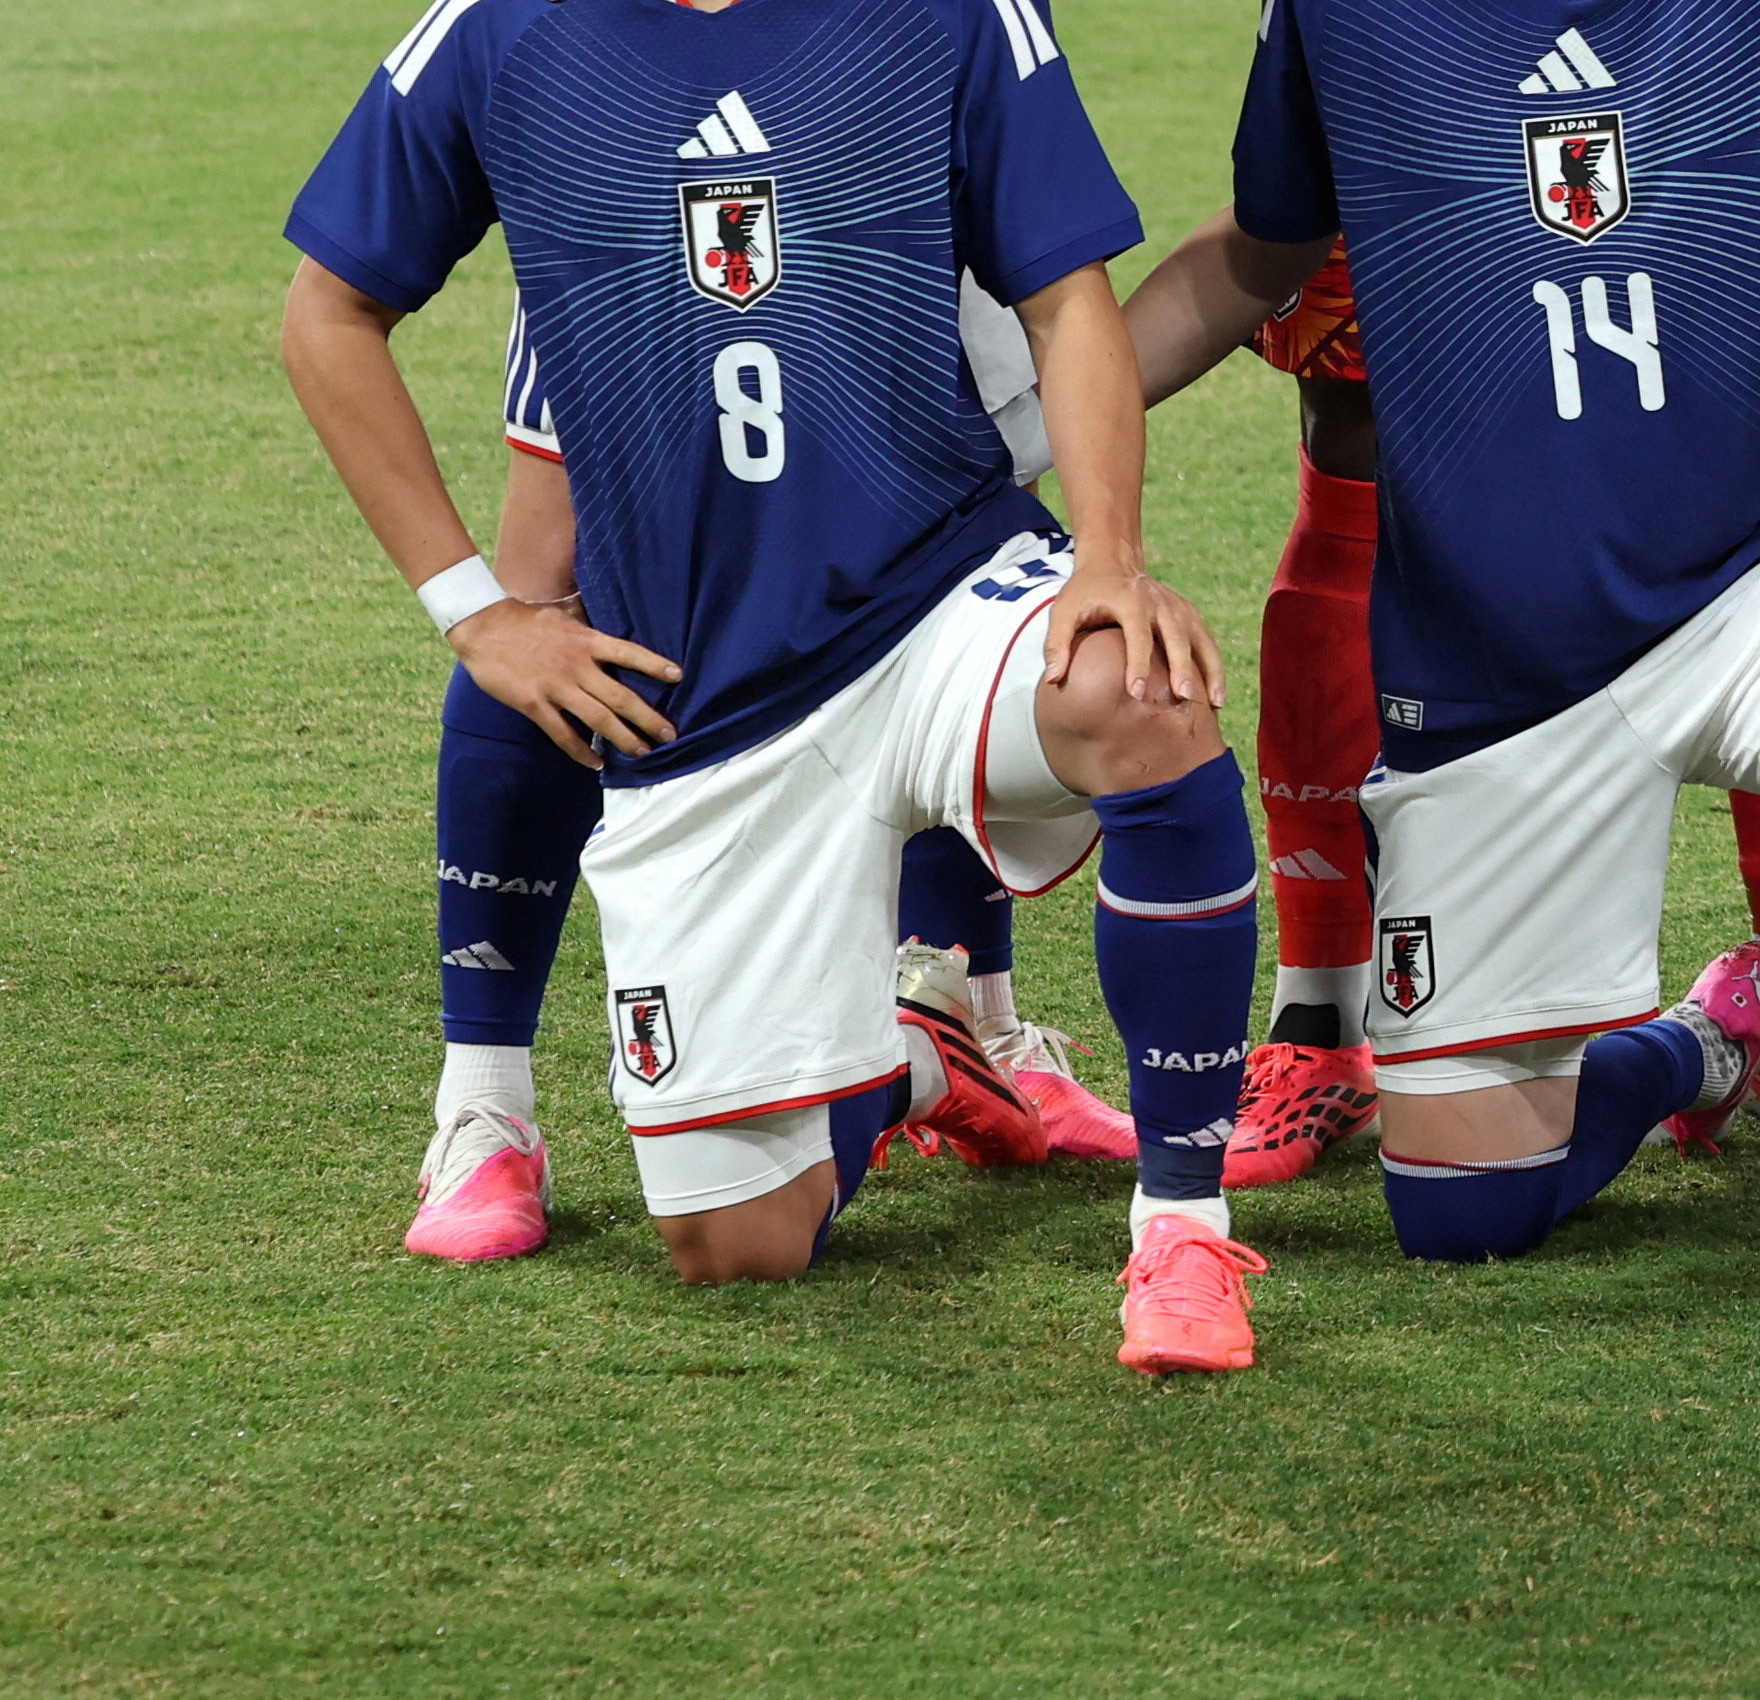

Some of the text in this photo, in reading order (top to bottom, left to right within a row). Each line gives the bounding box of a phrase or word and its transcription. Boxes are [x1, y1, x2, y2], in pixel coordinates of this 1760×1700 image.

[1548, 119, 1598, 133] JAPAN
[704, 185, 753, 198] JAPAN
[1561, 200, 1605, 222] JFA
[719, 266, 759, 288] JFA
[1532, 272, 1666, 420] 14
[713, 341, 785, 483] 8
[1387, 920, 1416, 929] JAPAN
[623, 989, 652, 1000] JAPAN
